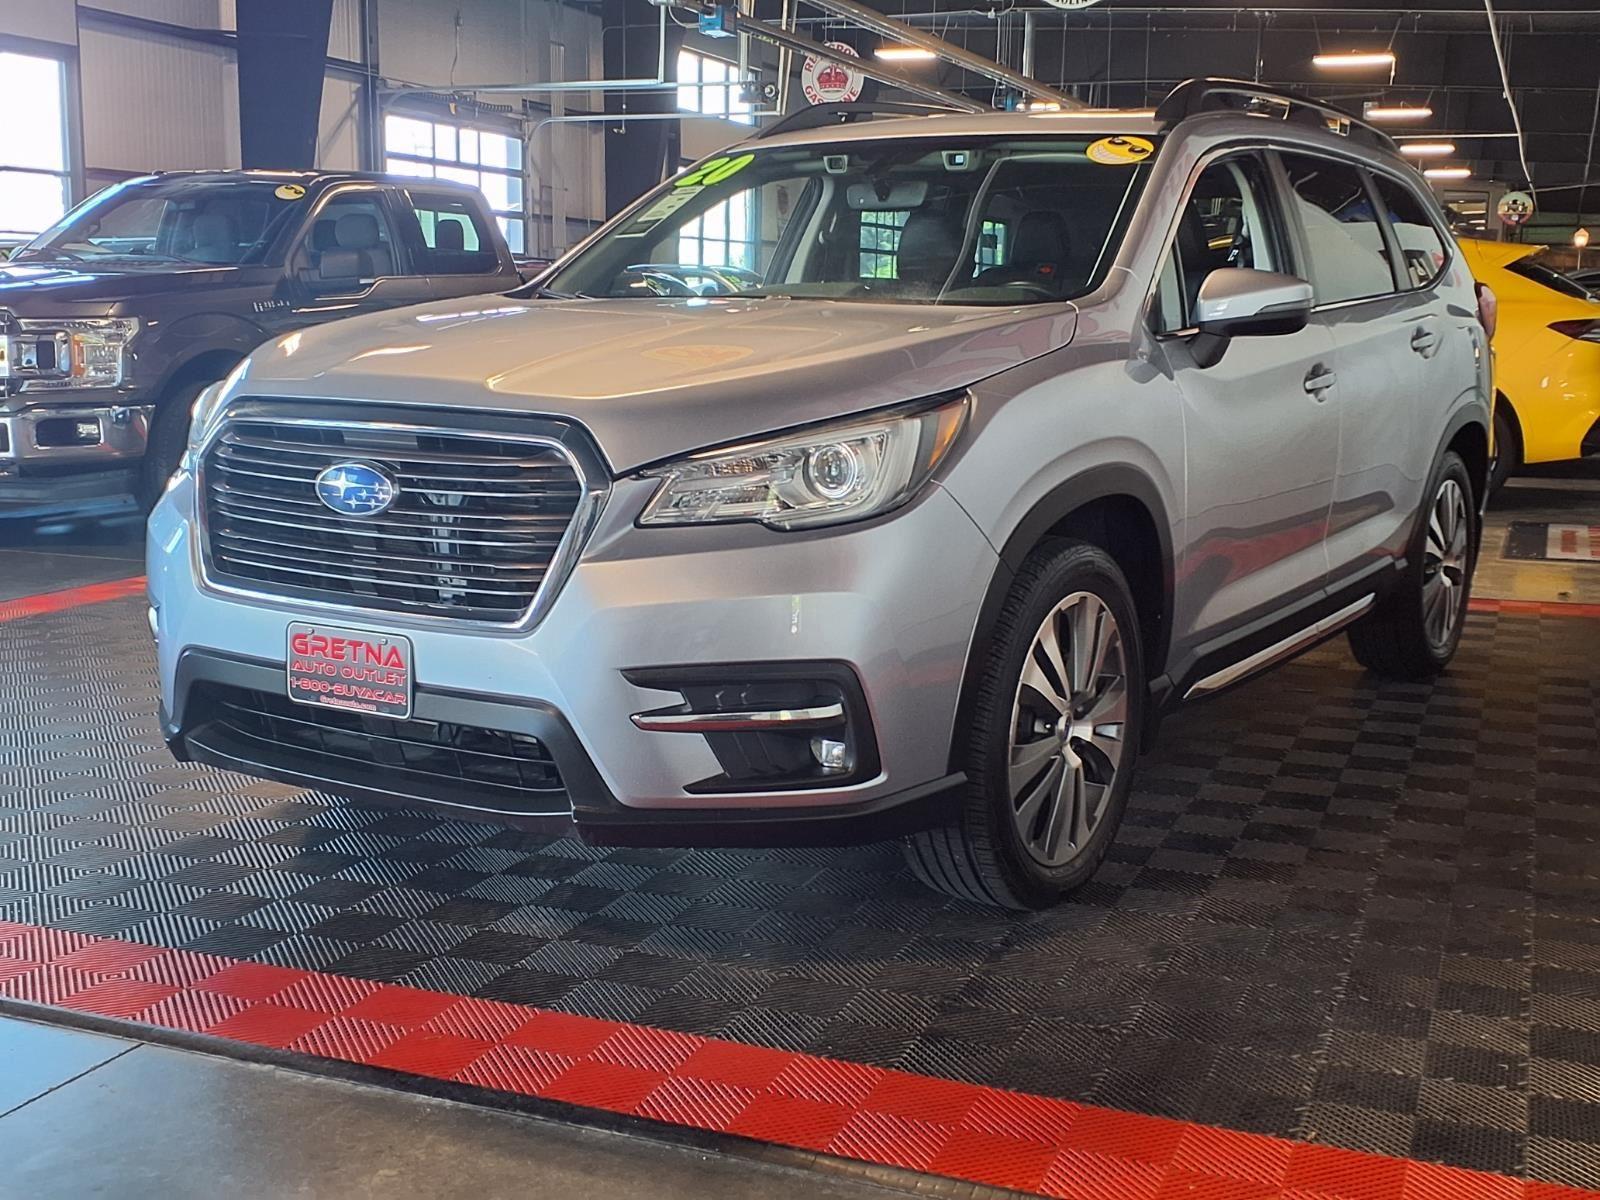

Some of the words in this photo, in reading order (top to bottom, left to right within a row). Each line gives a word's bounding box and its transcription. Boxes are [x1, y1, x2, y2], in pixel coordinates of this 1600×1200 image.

[674, 153, 755, 186] 20
[292, 634, 405, 670] GRETNA
[292, 660, 337, 676] AUTO
[340, 666, 406, 686] OUTLET
[291, 676, 406, 705] 1-800-BUYACAR
